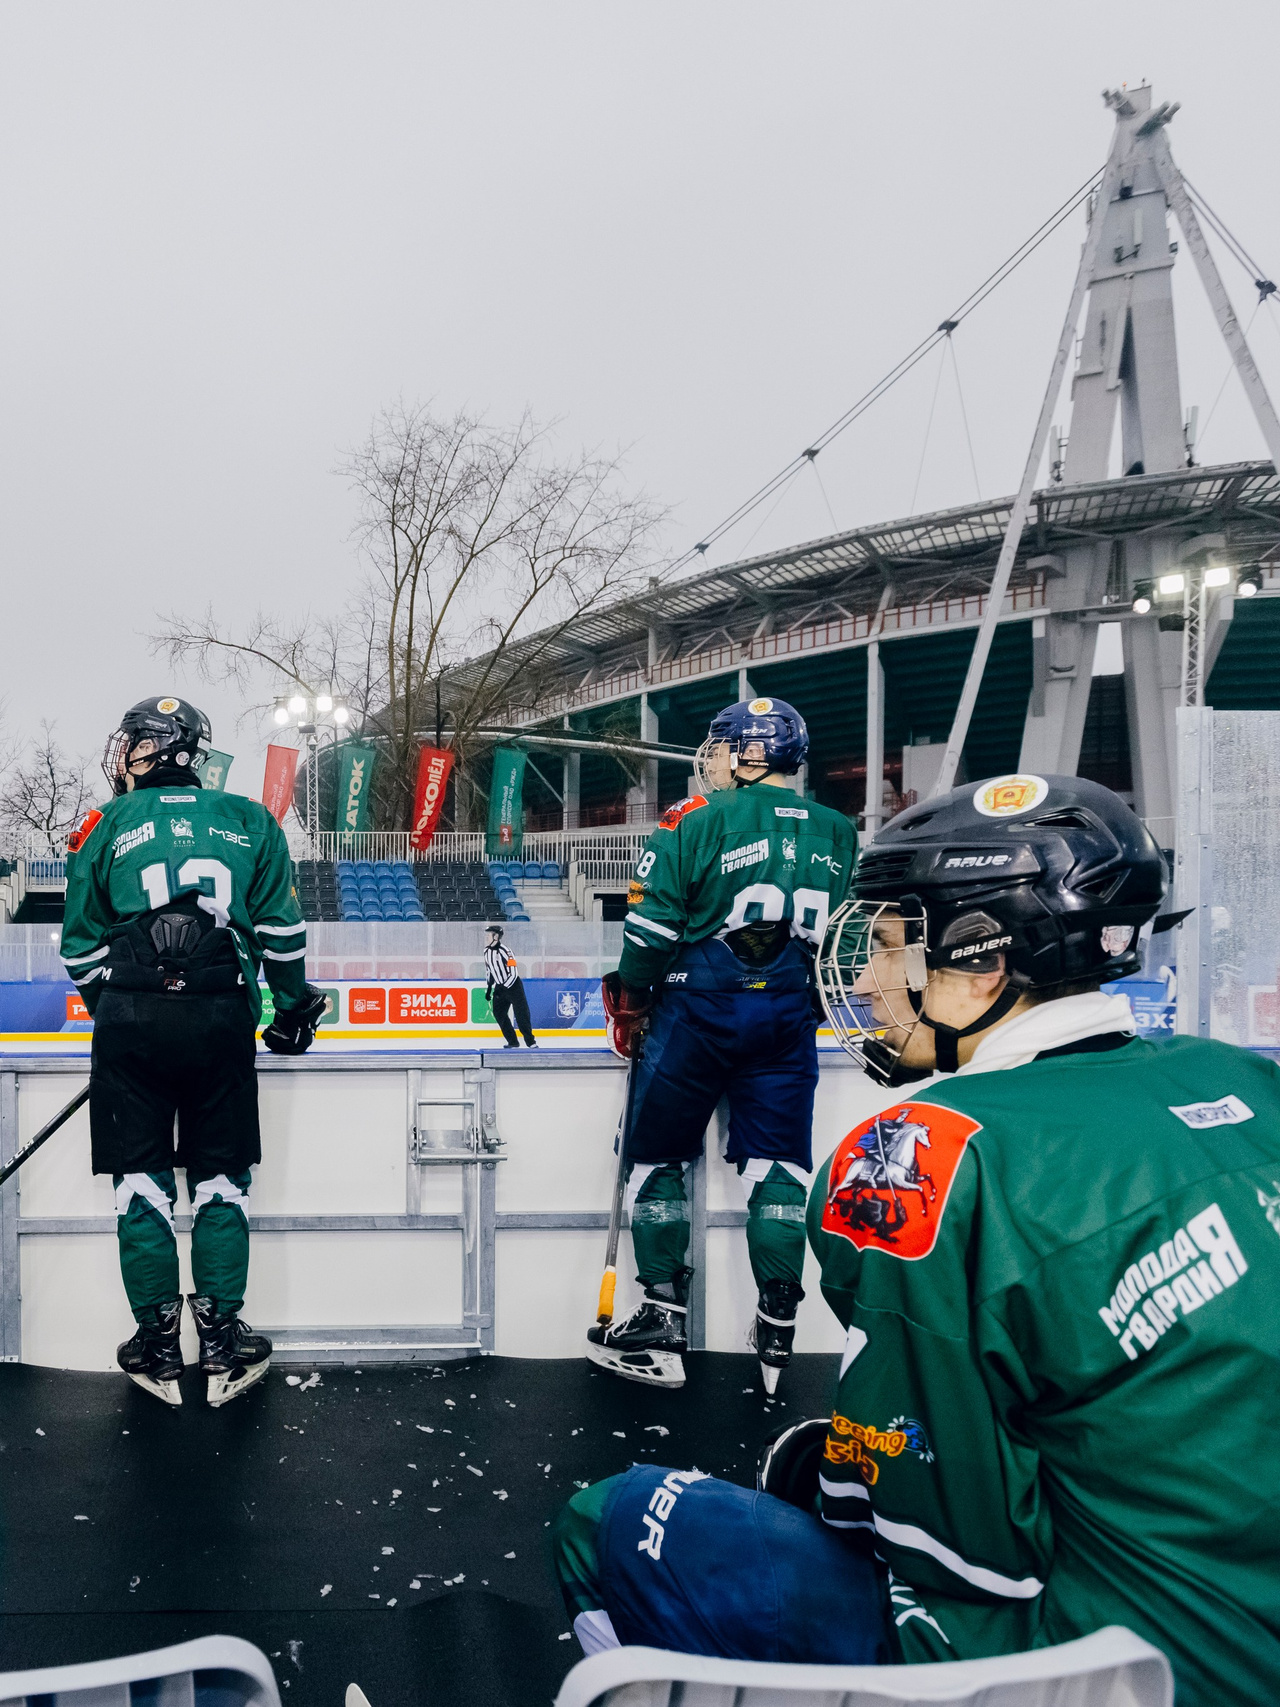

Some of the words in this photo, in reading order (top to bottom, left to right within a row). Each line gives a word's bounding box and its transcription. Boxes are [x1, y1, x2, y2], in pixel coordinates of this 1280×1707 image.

[950, 934, 1013, 960] BAUER
[400, 994, 457, 1007] ЗИМА
[1098, 1202, 1248, 1337] МОЛОДАЯ
